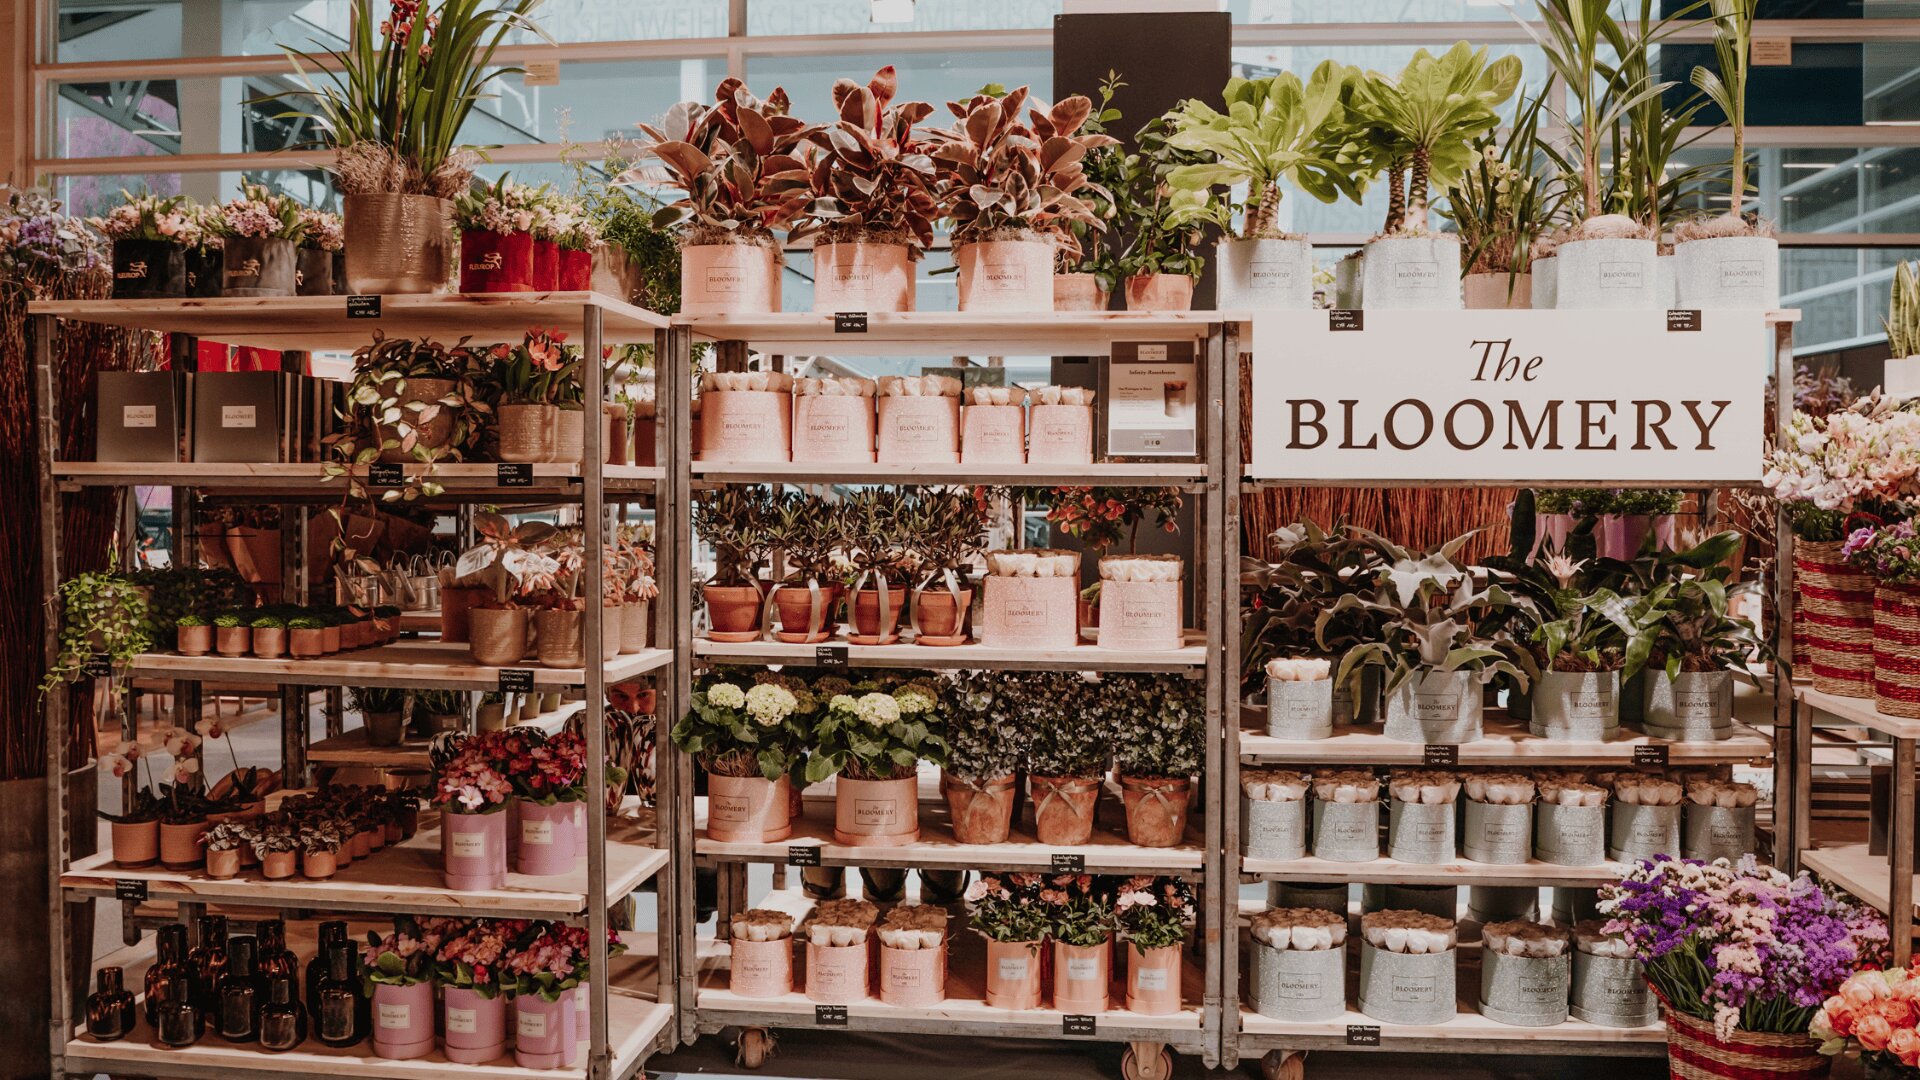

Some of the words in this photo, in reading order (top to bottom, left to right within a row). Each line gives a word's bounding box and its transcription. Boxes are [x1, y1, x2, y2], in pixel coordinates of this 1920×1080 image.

[1469, 338, 1544, 382] The
[1285, 398, 1732, 451] BLOOMERY
[1417, 703, 1456, 711] BLOOMERY
[715, 804, 747, 812] BLOOMERY
[1395, 985, 1432, 993] BLOOMERY
